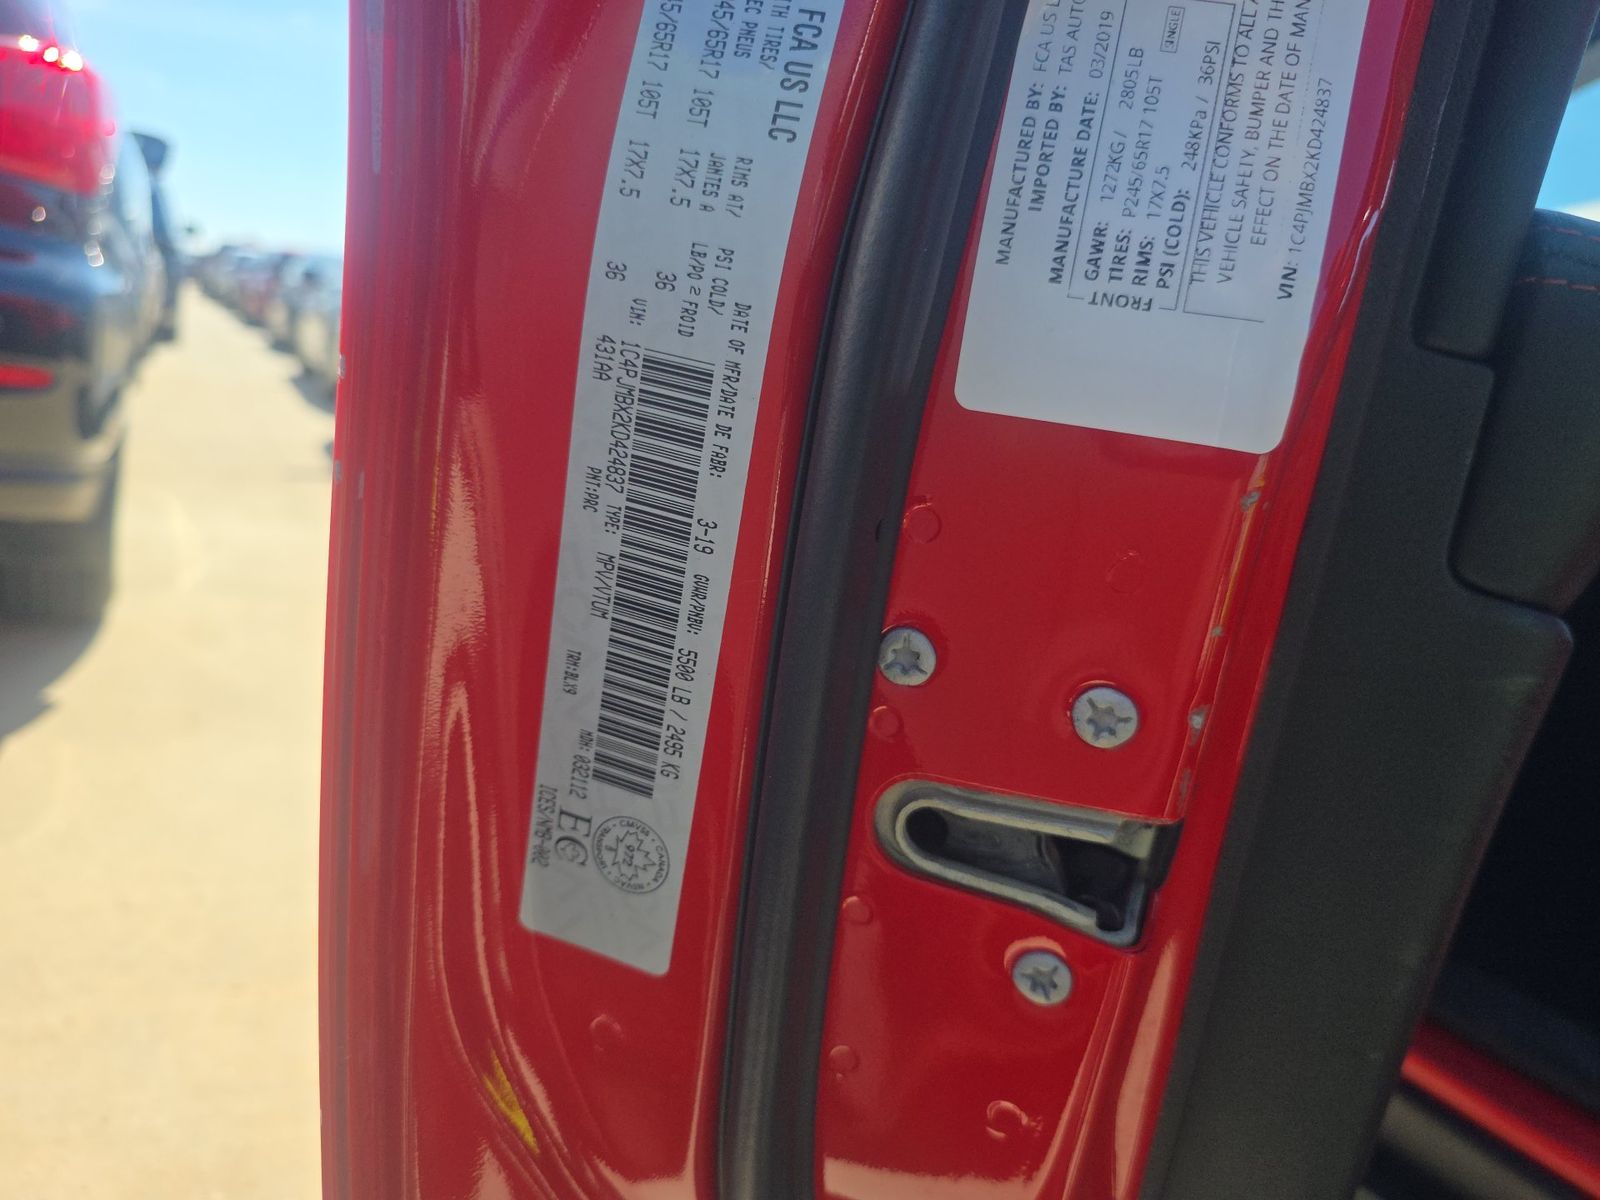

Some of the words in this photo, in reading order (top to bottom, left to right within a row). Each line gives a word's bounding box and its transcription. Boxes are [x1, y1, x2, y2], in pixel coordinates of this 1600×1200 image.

[699, 0, 735, 78] 45/65R17
[733, 21, 758, 58] PNEUS
[789, 8, 826, 50] FCA
[1039, 12, 1057, 35] US
[1235, 6, 1257, 39] ALL
[759, 27, 784, 69] TIRES/
[1032, 41, 1052, 71] FCA
[1197, 40, 1220, 84] 36PSI
[1230, 41, 1249, 66] TO
[1284, 42, 1301, 66] OF
[779, 60, 813, 92] US
[1274, 71, 1296, 114] DATE
[636, 80, 662, 119] 105T
[687, 88, 713, 127] 105T
[1025, 83, 1043, 109] BY:
[767, 99, 803, 142] LLC
[1027, 118, 1058, 211] IMPORTED
[1048, 85, 1066, 112] BY:
[1057, 45, 1076, 74] TAS
[1211, 71, 1243, 168] CONFORMS
[1267, 119, 1288, 149] THE
[1048, 146, 1087, 284] MANUFACTURE
[1076, 92, 1099, 140] DATE:
[1088, 10, 1113, 78] 03/2019
[1180, 110, 1206, 171] 248KPa
[1216, 215, 1244, 283] VEHICLE
[1244, 70, 1271, 140] BUMPER
[1259, 27, 1278, 65] AND
[618, 139, 649, 198] 17X7.5
[669, 148, 700, 208] 17X7.5
[701, 152, 723, 197] JANTES
[730, 156, 753, 187] RIMS
[1084, 222, 1107, 280] GAWR:
[1118, 47, 1143, 109] 2805LB
[1108, 229, 1131, 281] TIRES:
[1121, 119, 1152, 217] P245/65R17
[1142, 75, 1162, 113] 105T
[1263, 156, 1281, 181] ON
[725, 194, 743, 217] AT/
[995, 116, 1035, 264] MANUFACTURED
[1196, 171, 1225, 242] VEHICLE
[1277, 262, 1297, 299] VIN:
[1288, 77, 1331, 252] 1C4PJMBX2KD424837
[1131, 236, 1154, 285] RIMS:
[1146, 166, 1169, 218] 17X7.5
[1162, 189, 1190, 256] (COLD):
[1249, 186, 1274, 245] EFFECT
[605, 261, 627, 281] 36
[686, 242, 707, 280] LB/PO
[714, 247, 734, 270] PSI
[1156, 262, 1174, 288] PSI
[1188, 244, 1210, 284] THIS
[654, 271, 676, 291] 36
[707, 277, 728, 315] COLD/
[629, 298, 646, 325] VIN:
[677, 300, 698, 337] FROID
[730, 302, 751, 333] DATE
[1088, 291, 1152, 311] FRONT
[592, 334, 616, 381] 431AA
[728, 339, 745, 355] OF
[717, 360, 741, 418] MFR/DATE
[605, 340, 640, 493] 1C4PJMBX2KD424837
[714, 423, 732, 439] DE
[708, 443, 728, 477] FABR:
[604, 504, 621, 534] TYPE:
[693, 518, 717, 554] 3-19
[590, 551, 615, 619] MPV/VTUM
[674, 647, 697, 681] 5500
[669, 708, 686, 719] /
[671, 686, 691, 705] LB
[663, 724, 685, 758] 2495
[660, 761, 679, 779] KG
[622, 844, 636, 867] 972
